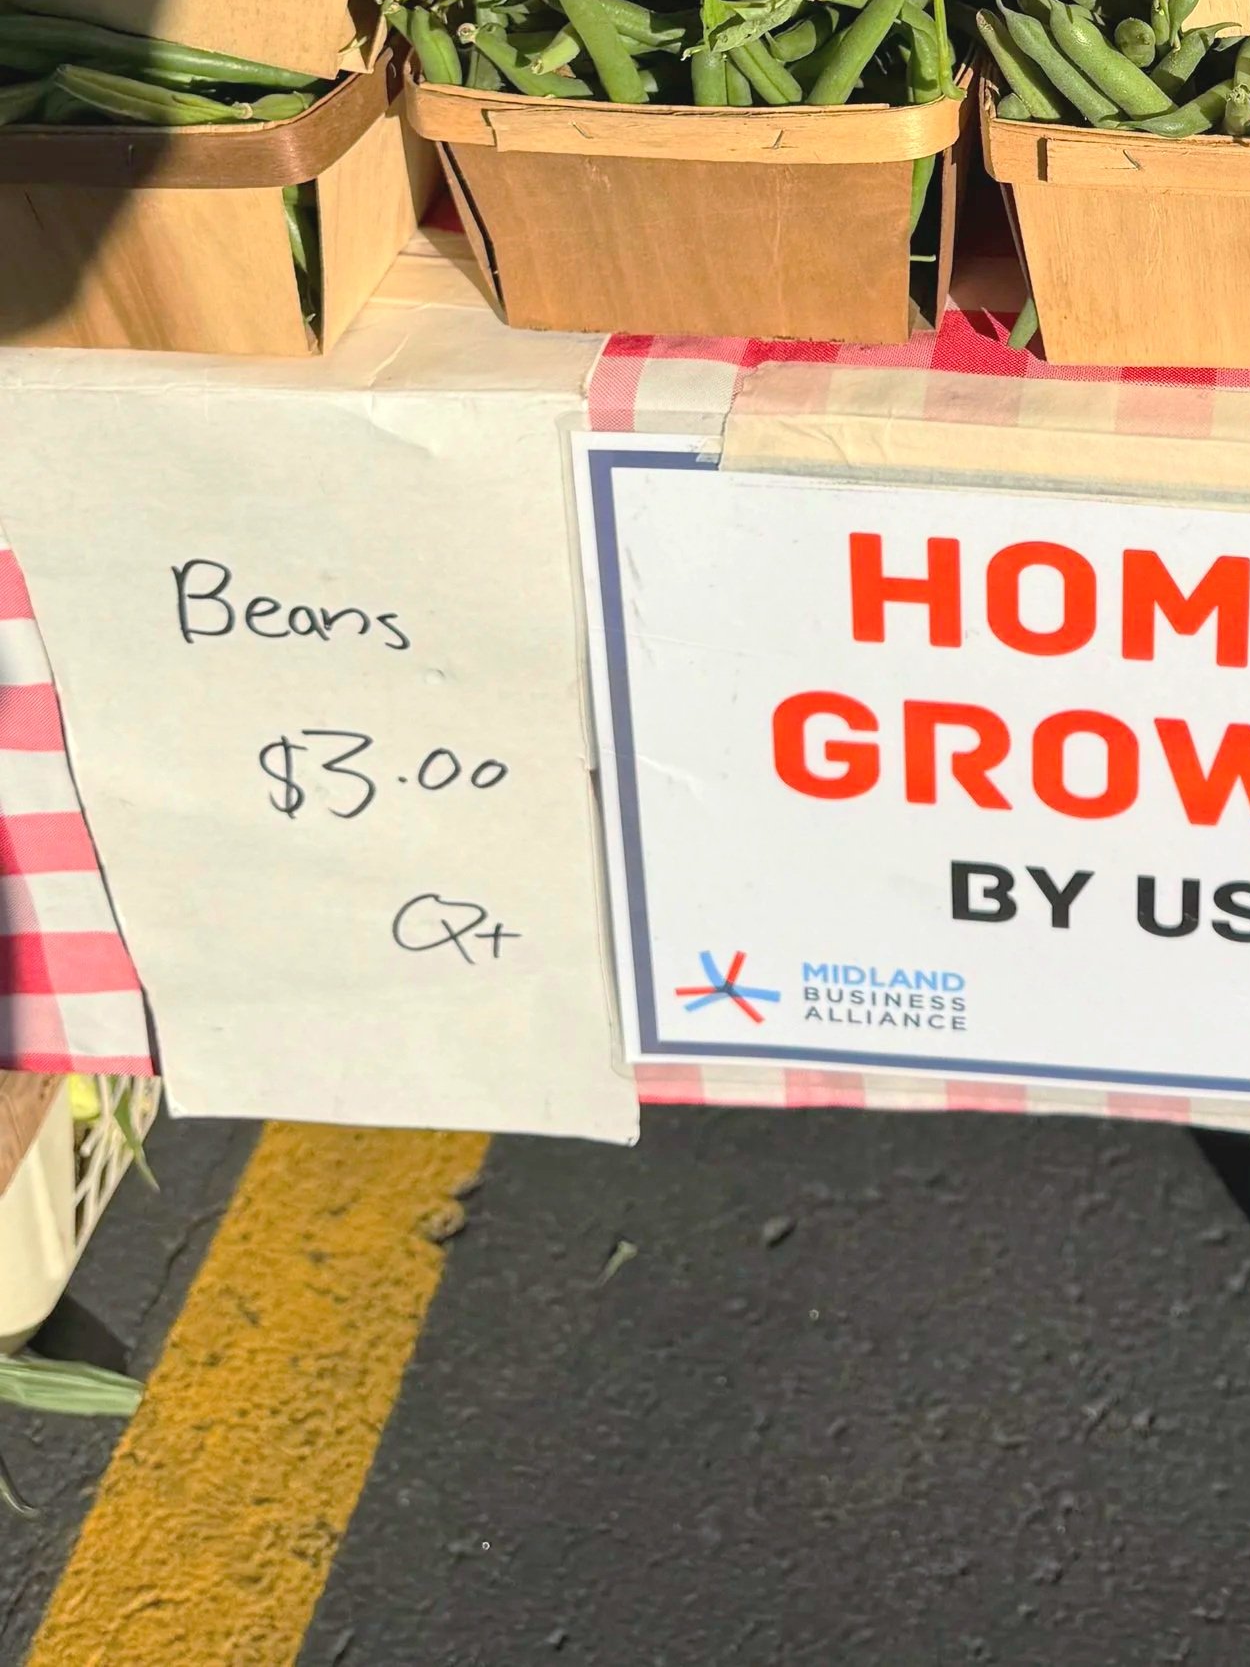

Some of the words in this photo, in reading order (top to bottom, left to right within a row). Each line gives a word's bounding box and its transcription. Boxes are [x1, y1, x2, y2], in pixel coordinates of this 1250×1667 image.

[171, 558, 410, 650] Beans
[258, 729, 509, 820] $3.00
[950, 860, 1095, 930] BY
[802, 961, 966, 993] MIDLAND
[804, 986, 967, 1012] BUSINESS
[804, 1006, 967, 1031] ALLIANCE
